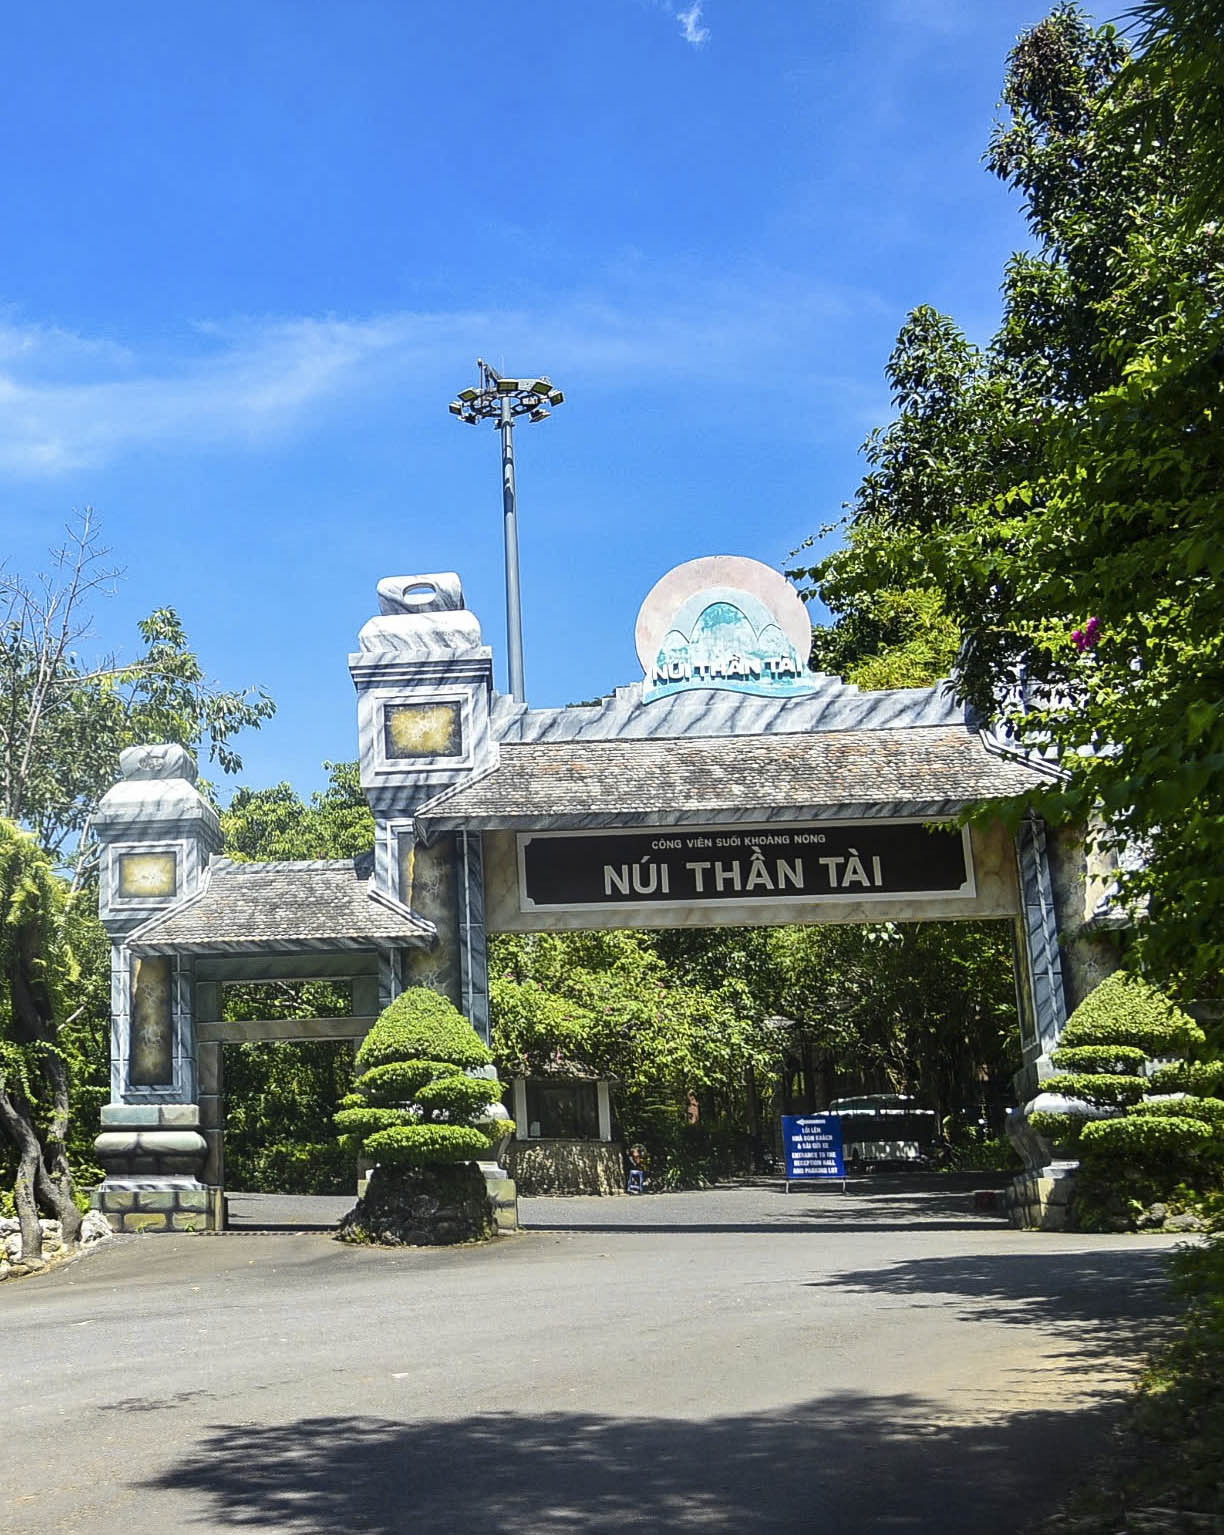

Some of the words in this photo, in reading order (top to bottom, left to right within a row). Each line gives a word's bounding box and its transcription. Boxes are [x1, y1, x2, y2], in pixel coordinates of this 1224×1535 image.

[652, 838, 682, 849] CÔNG
[687, 836, 712, 848] VIÊN
[716, 834, 741, 847] SUỐI
[604, 855, 669, 895] NÚI
[686, 846, 804, 892] THẦN
[819, 848, 883, 888] TÀI
